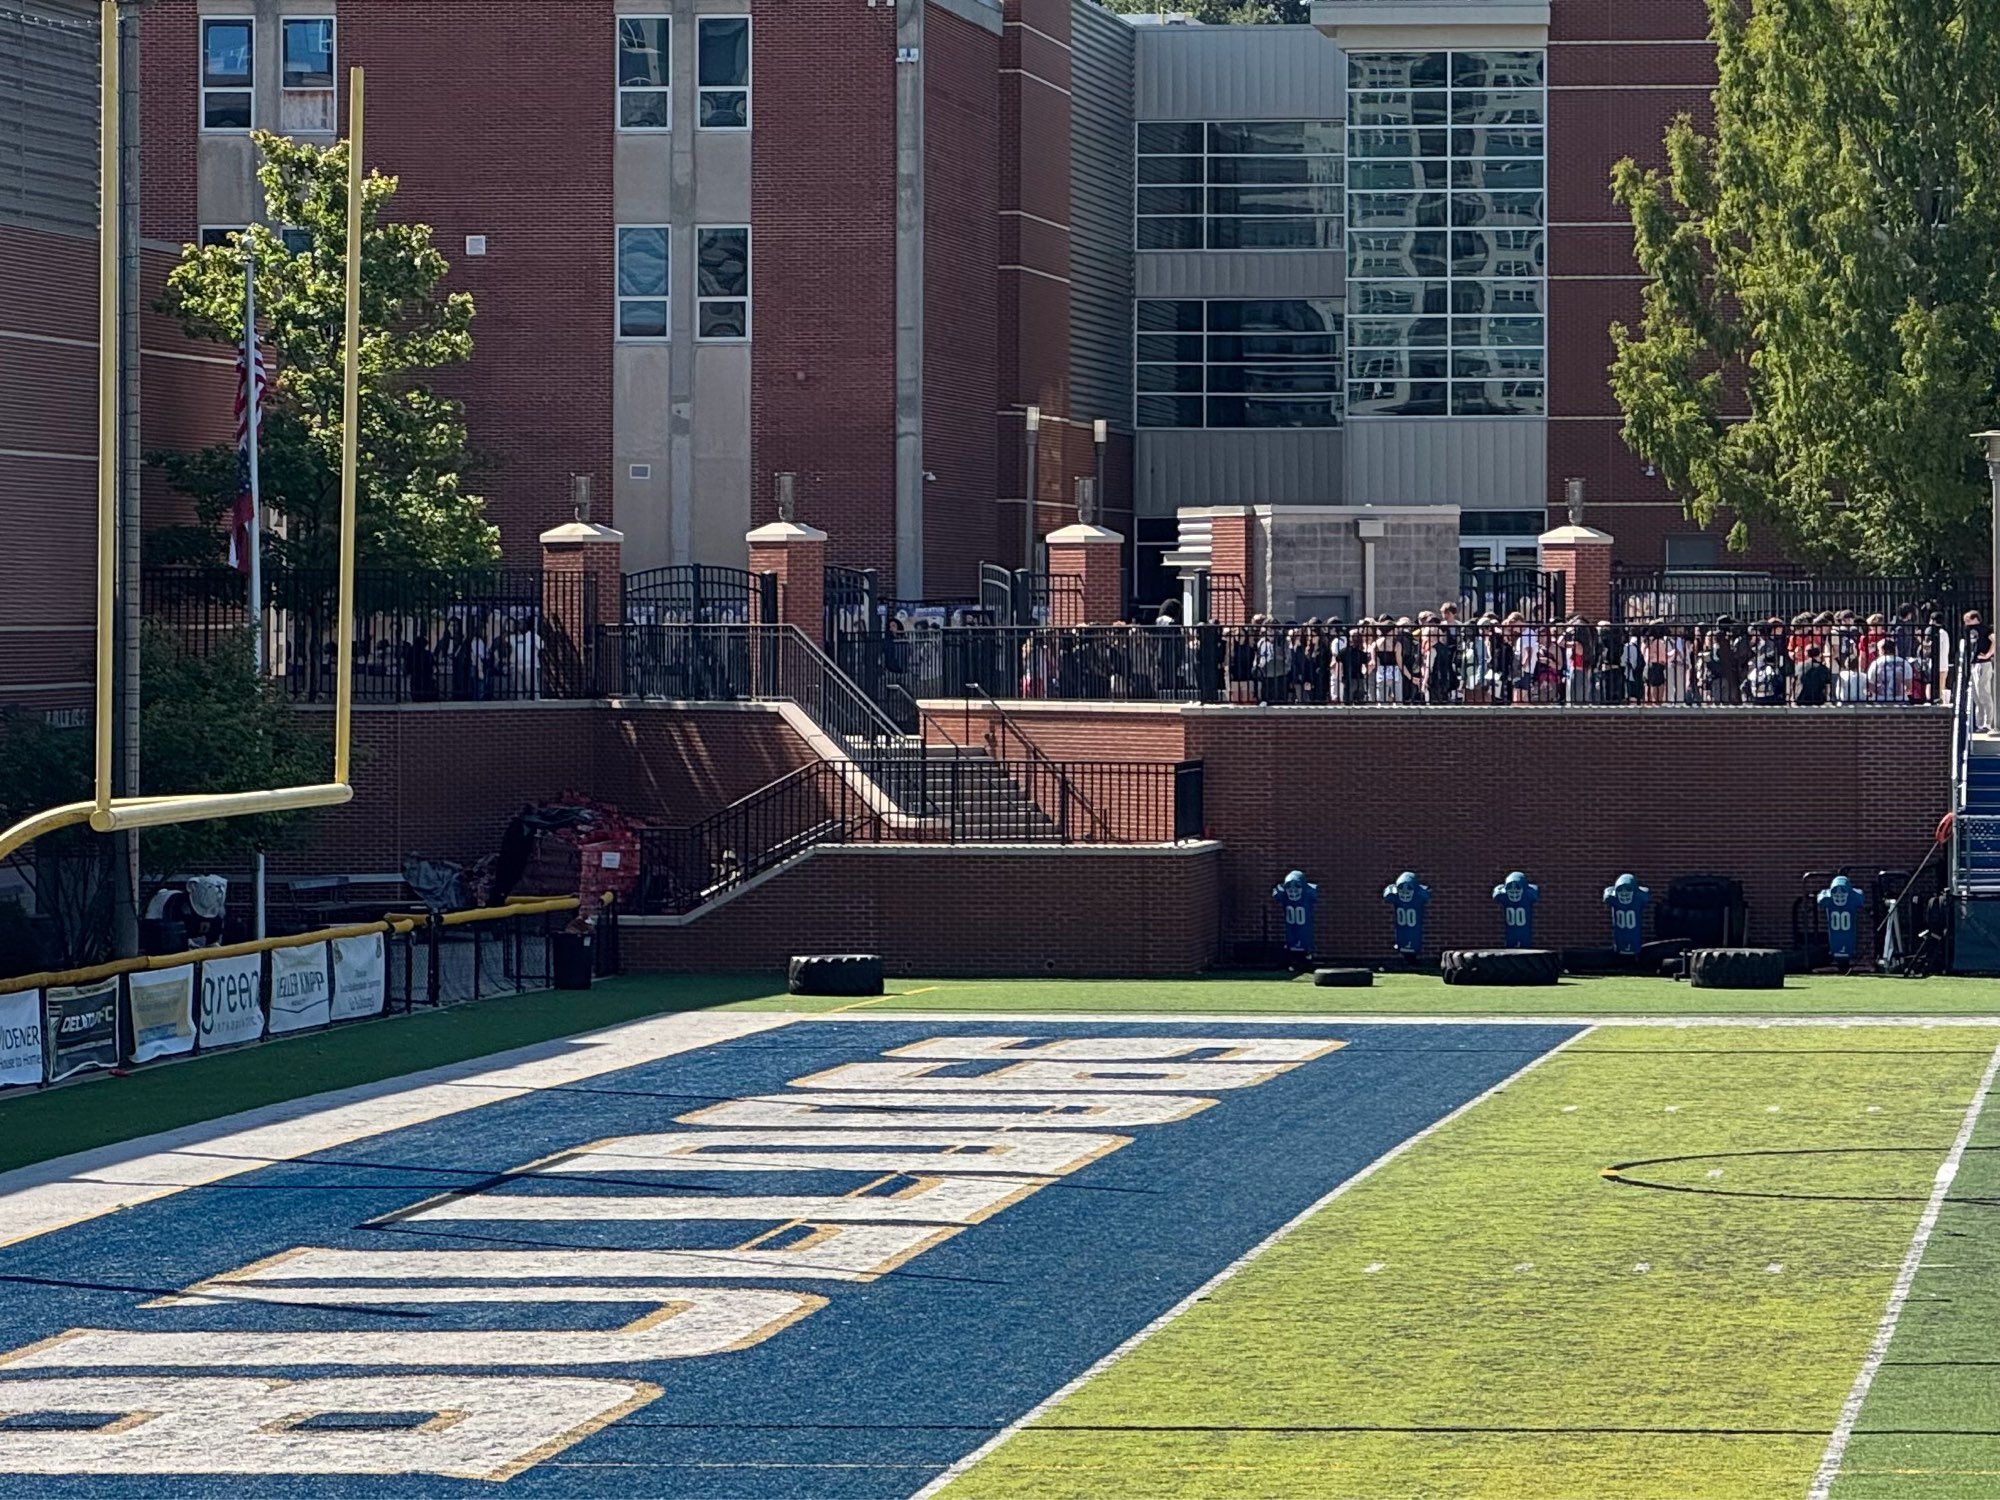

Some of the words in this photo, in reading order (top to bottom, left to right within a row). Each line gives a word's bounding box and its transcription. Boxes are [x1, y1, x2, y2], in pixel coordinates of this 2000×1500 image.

[1285, 905, 1306, 925] 00
[1396, 907, 1417, 927] 00
[1505, 907, 1526, 927] 00
[1615, 909, 1636, 930] 00
[1830, 910, 1851, 931] 00
[202, 970, 260, 1035] green
